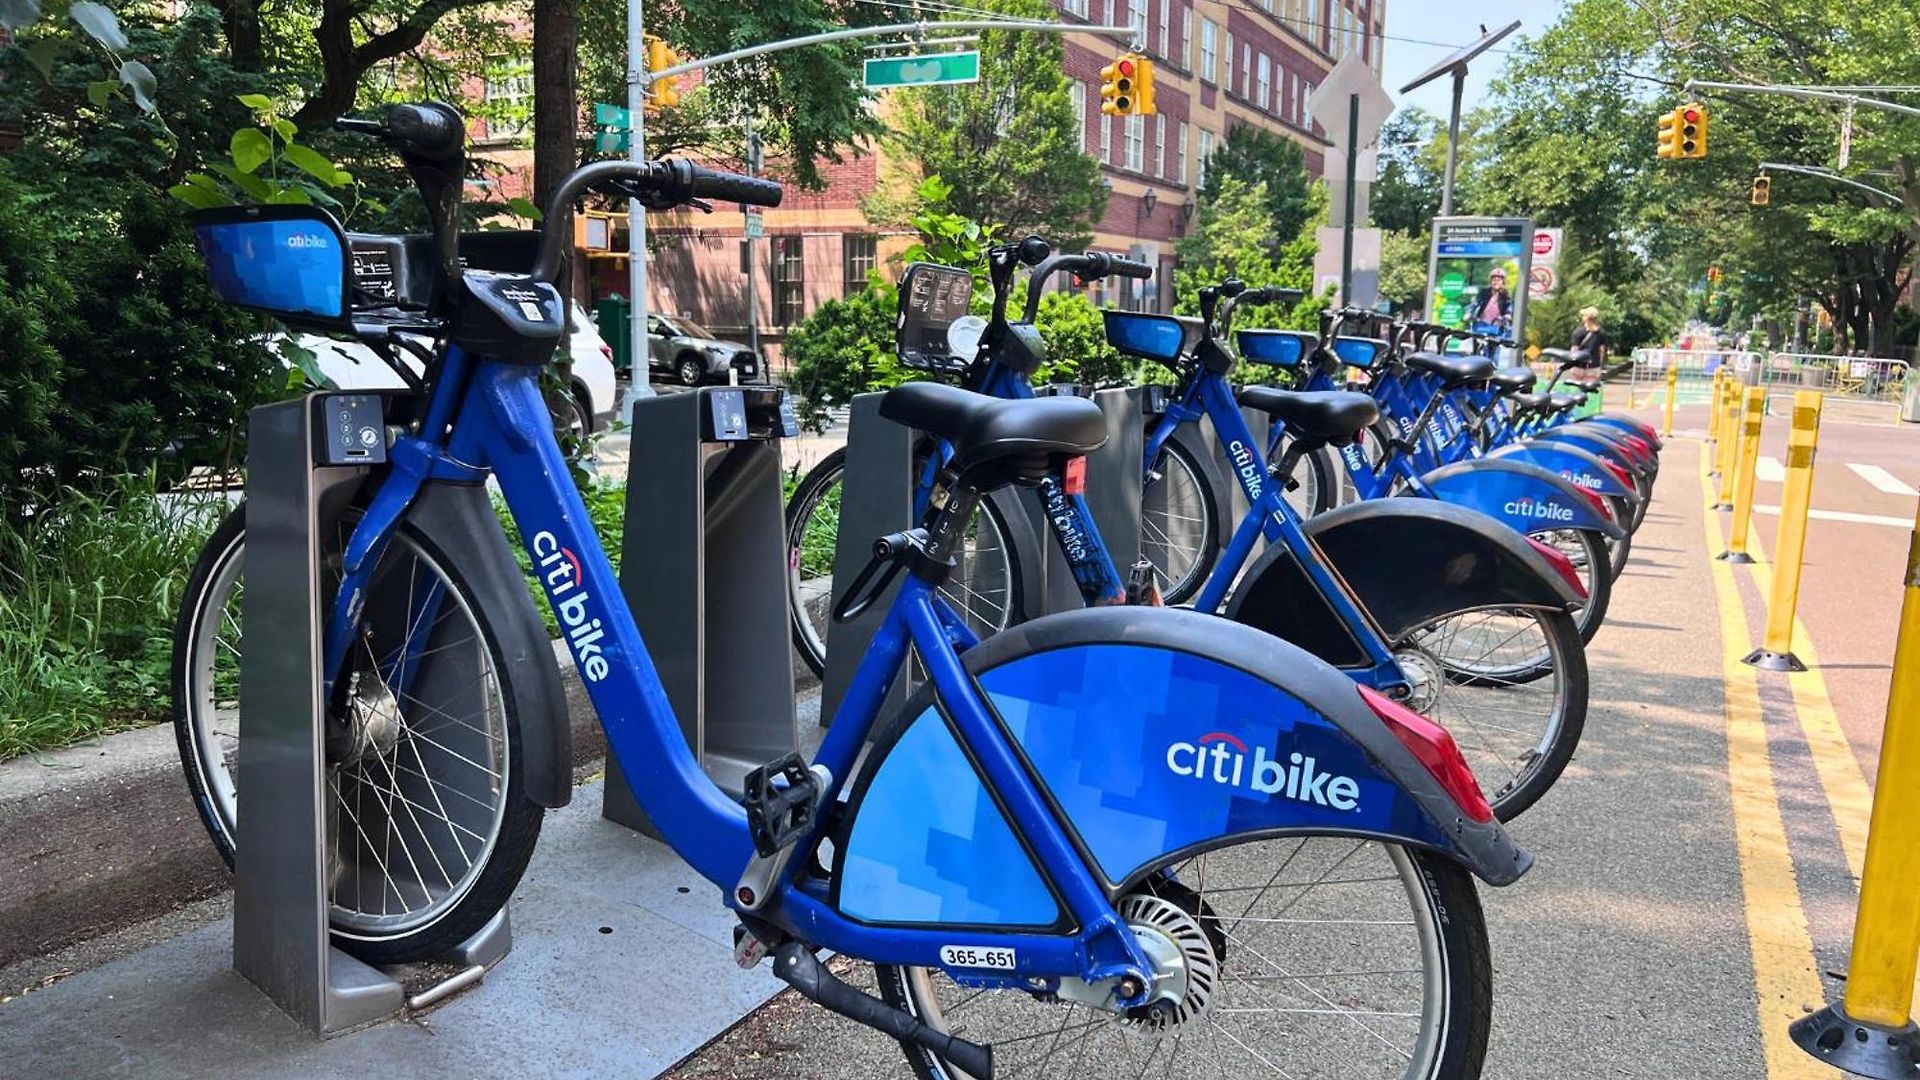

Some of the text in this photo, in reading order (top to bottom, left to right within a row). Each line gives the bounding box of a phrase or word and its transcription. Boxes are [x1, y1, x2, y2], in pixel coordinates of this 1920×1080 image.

[1230, 440, 1262, 500] citi bike
[1343, 442, 1361, 471] bike
[1573, 473, 1602, 488] bike
[1504, 501, 1574, 521] citi bike
[533, 531, 609, 682] citi bike
[1167, 742, 1360, 810] citi bike
[947, 949, 1015, 967] 365-651
